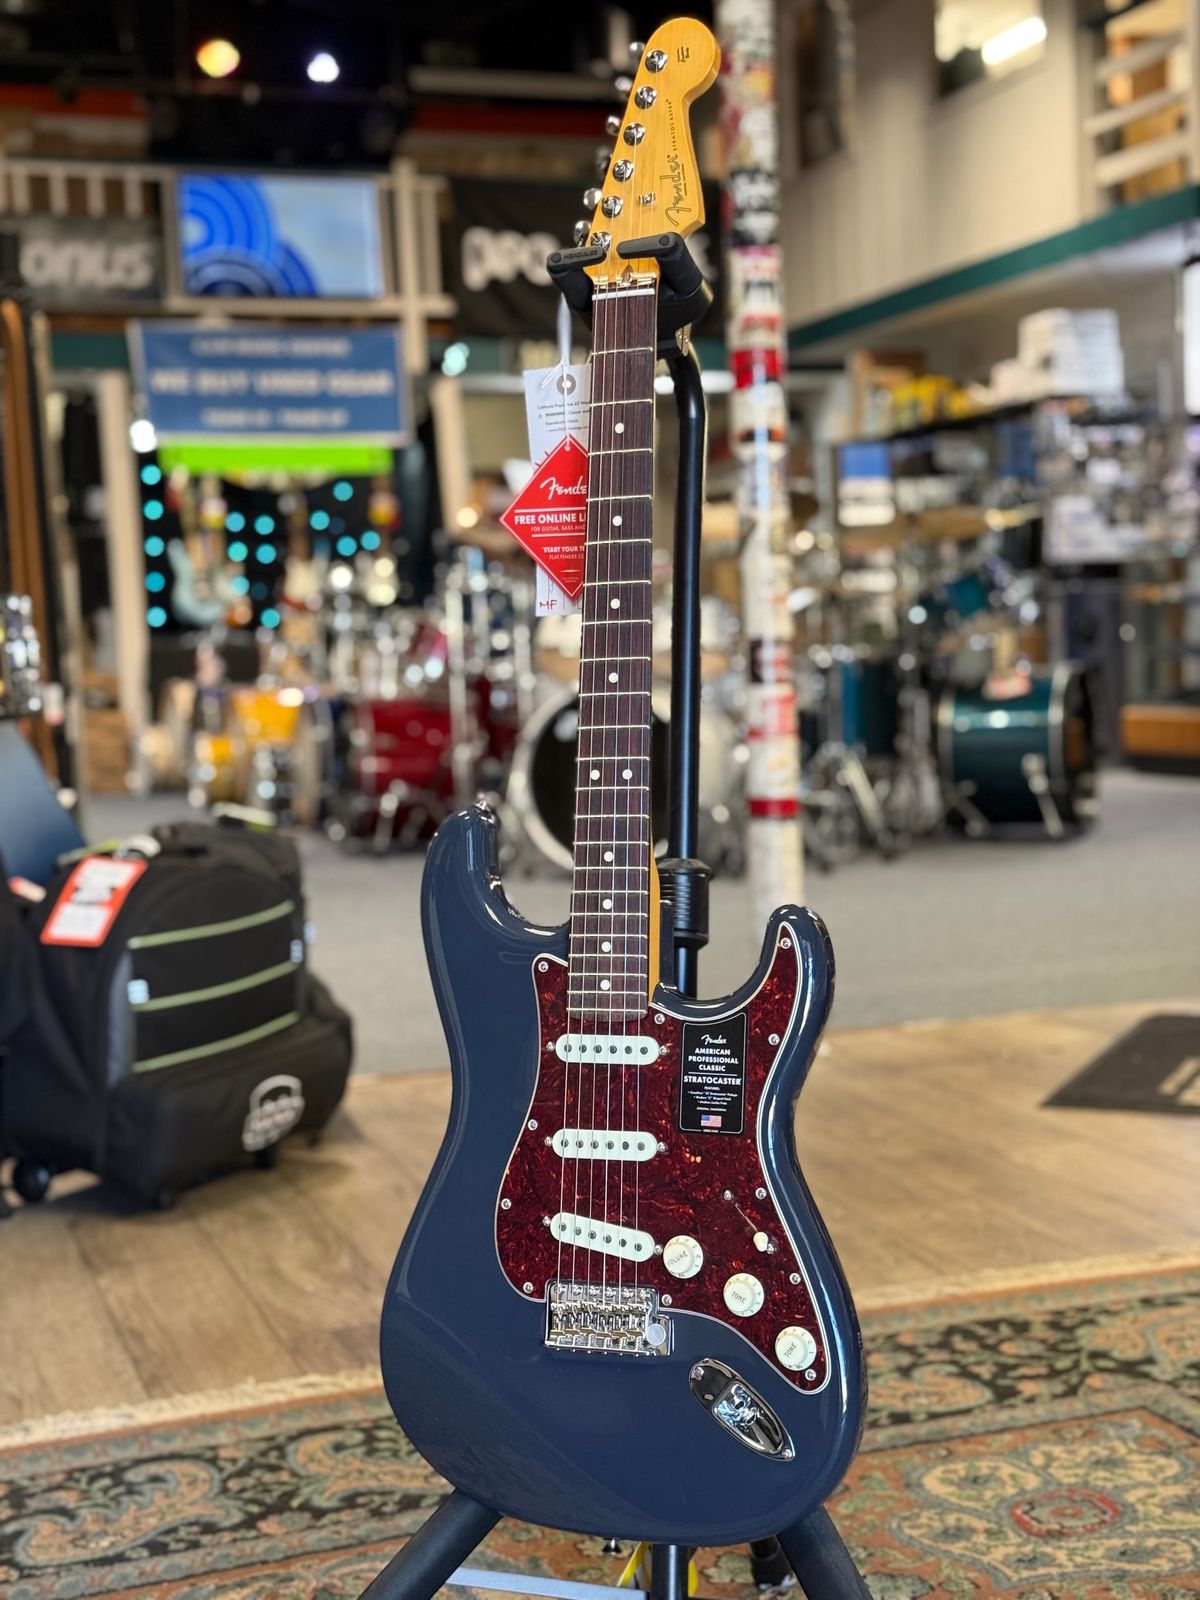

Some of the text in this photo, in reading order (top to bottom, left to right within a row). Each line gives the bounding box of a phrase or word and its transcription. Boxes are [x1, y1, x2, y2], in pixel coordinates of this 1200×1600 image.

[660, 154, 692, 227] Fender
[196, 371, 248, 393] BUY
[540, 475, 587, 500] Fende
[514, 515, 536, 525] FREE
[538, 513, 576, 524] ONLINE
[701, 1034, 727, 1045] Fender
[688, 1056, 739, 1064] PROFESSIONAL
[684, 1076, 742, 1085] STRATOCASTER
[732, 1291, 746, 1304] TONE
[784, 1342, 797, 1357] TONE
